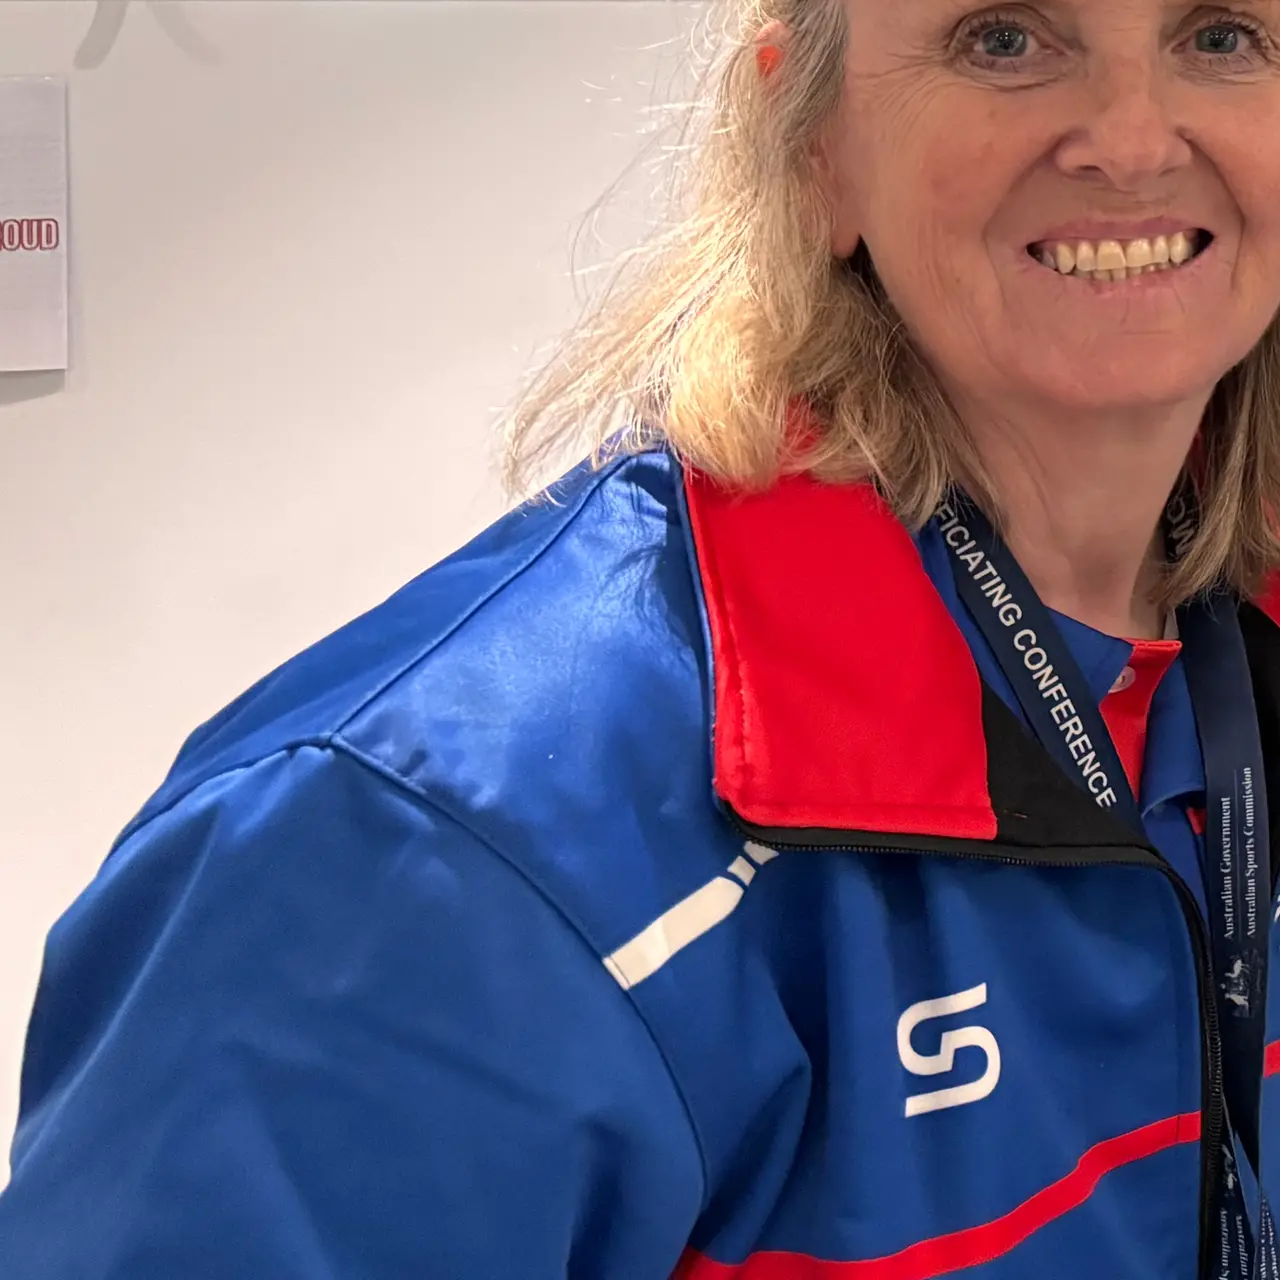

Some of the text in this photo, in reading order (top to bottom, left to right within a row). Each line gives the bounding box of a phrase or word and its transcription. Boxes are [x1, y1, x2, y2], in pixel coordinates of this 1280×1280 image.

[0, 219, 59, 251] OUD
[934, 503, 1117, 809] FICIATING CONFERENCE
[1219, 797, 1235, 939] Australian Government
[1242, 767, 1258, 937] Australian Sports Commission
